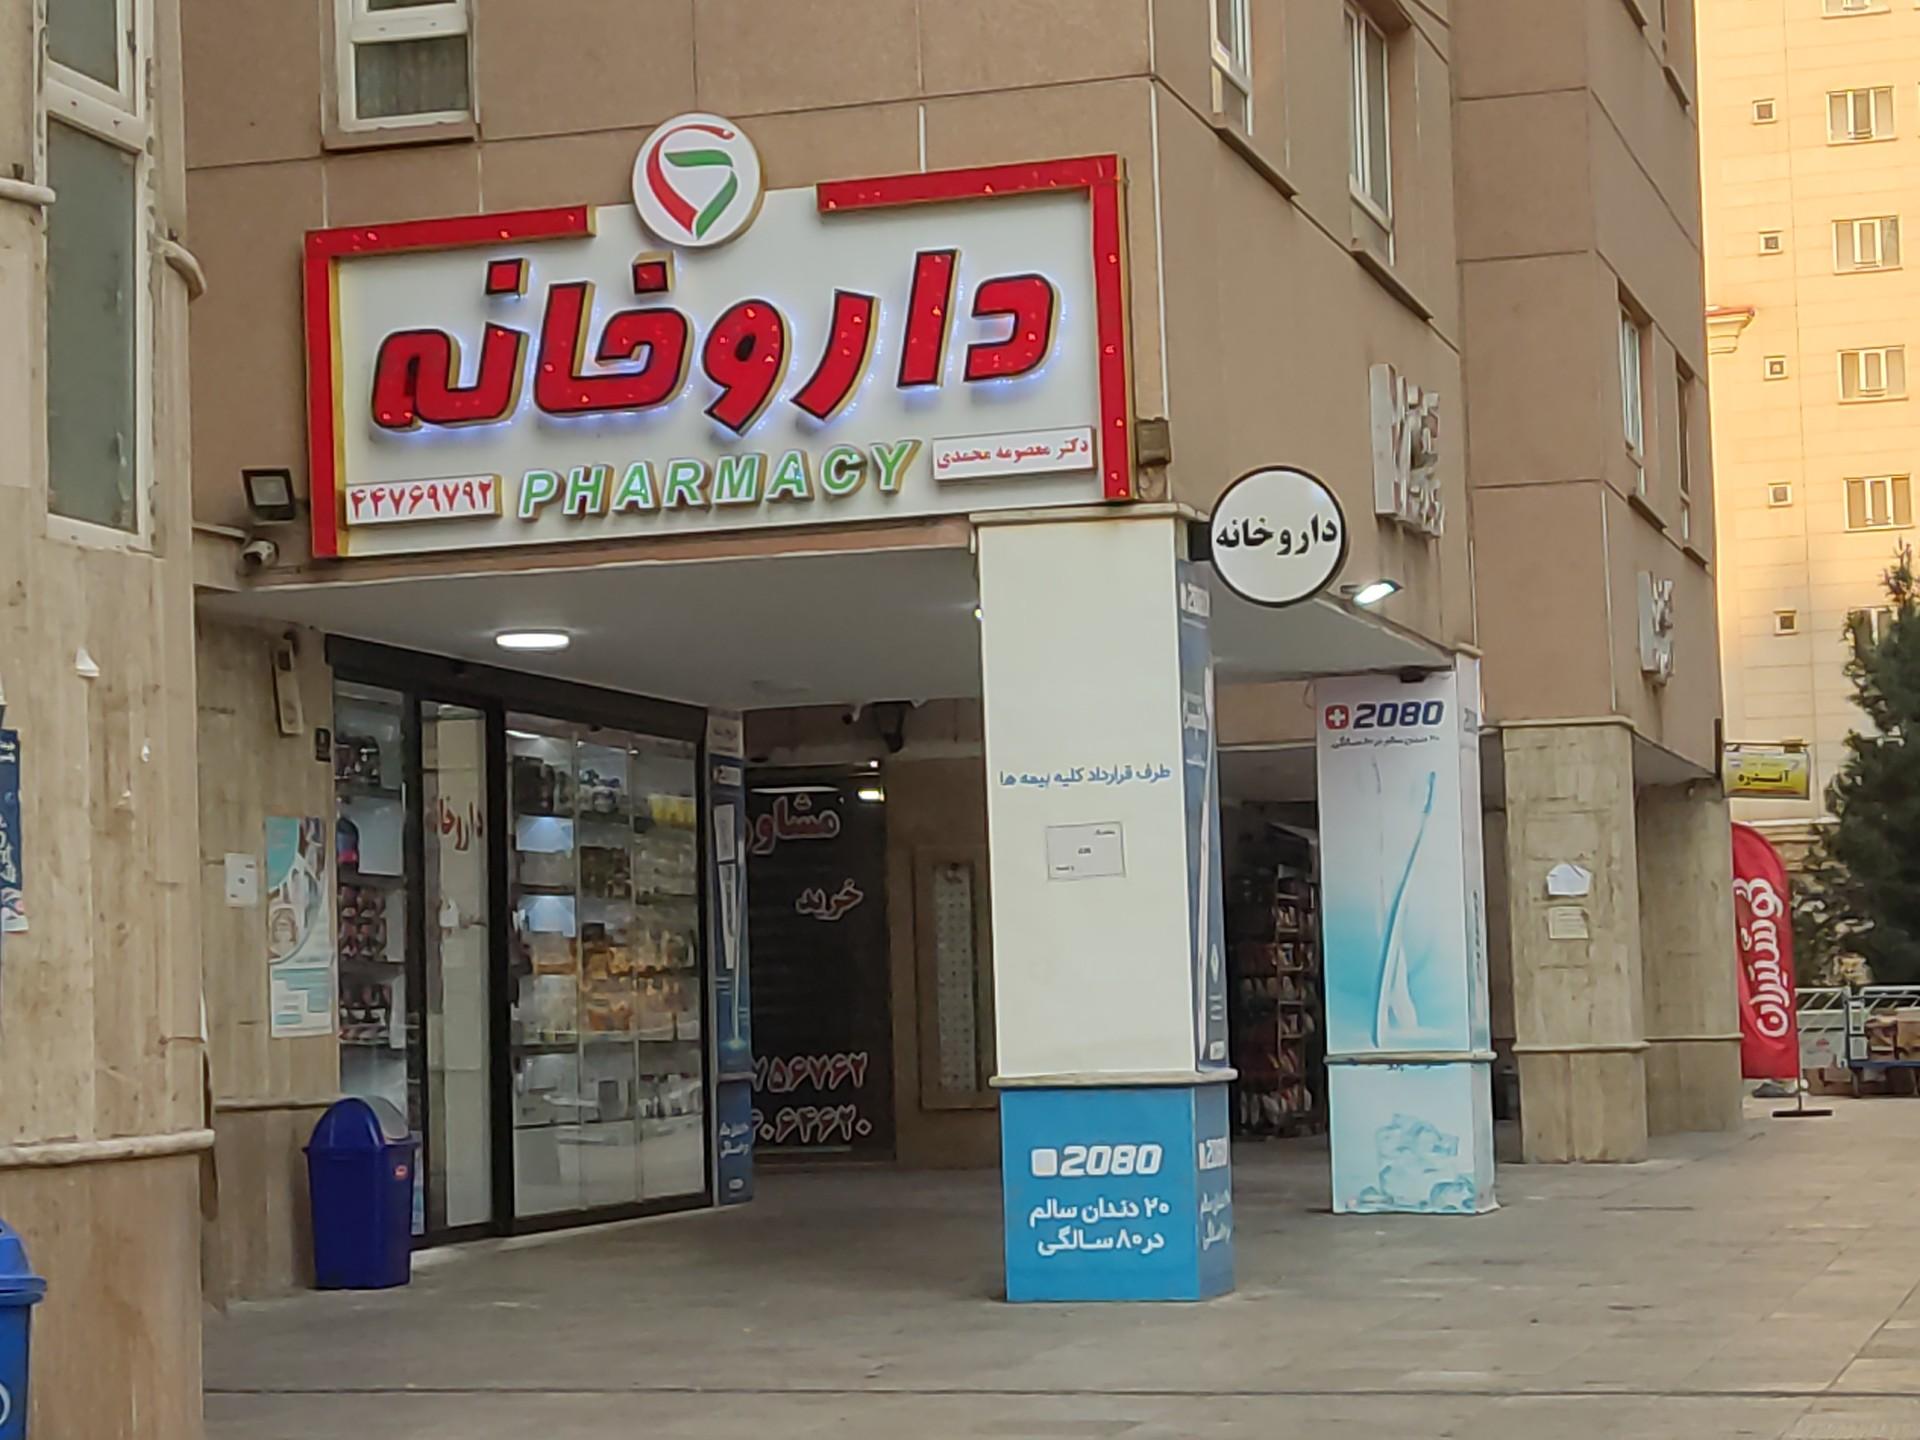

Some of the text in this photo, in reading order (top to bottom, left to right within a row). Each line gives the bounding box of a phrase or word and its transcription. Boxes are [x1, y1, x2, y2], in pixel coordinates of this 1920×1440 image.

[371, 249, 1062, 436] داروخانه
[937, 437, 1088, 469] دکتر معصومه محمدی
[518, 438, 919, 521] PHARMACY
[350, 480, 493, 520] ۴۴۷۶۹۷۹۲
[1215, 513, 1338, 556] داروخانه
[1353, 701, 1444, 729] 2080
[1000, 762, 1171, 788] طرف قرارداد کلیه بیمه ها
[1060, 1144, 1163, 1177] 2080
[1029, 1196, 1170, 1228] ۲۰ دندان سالم
